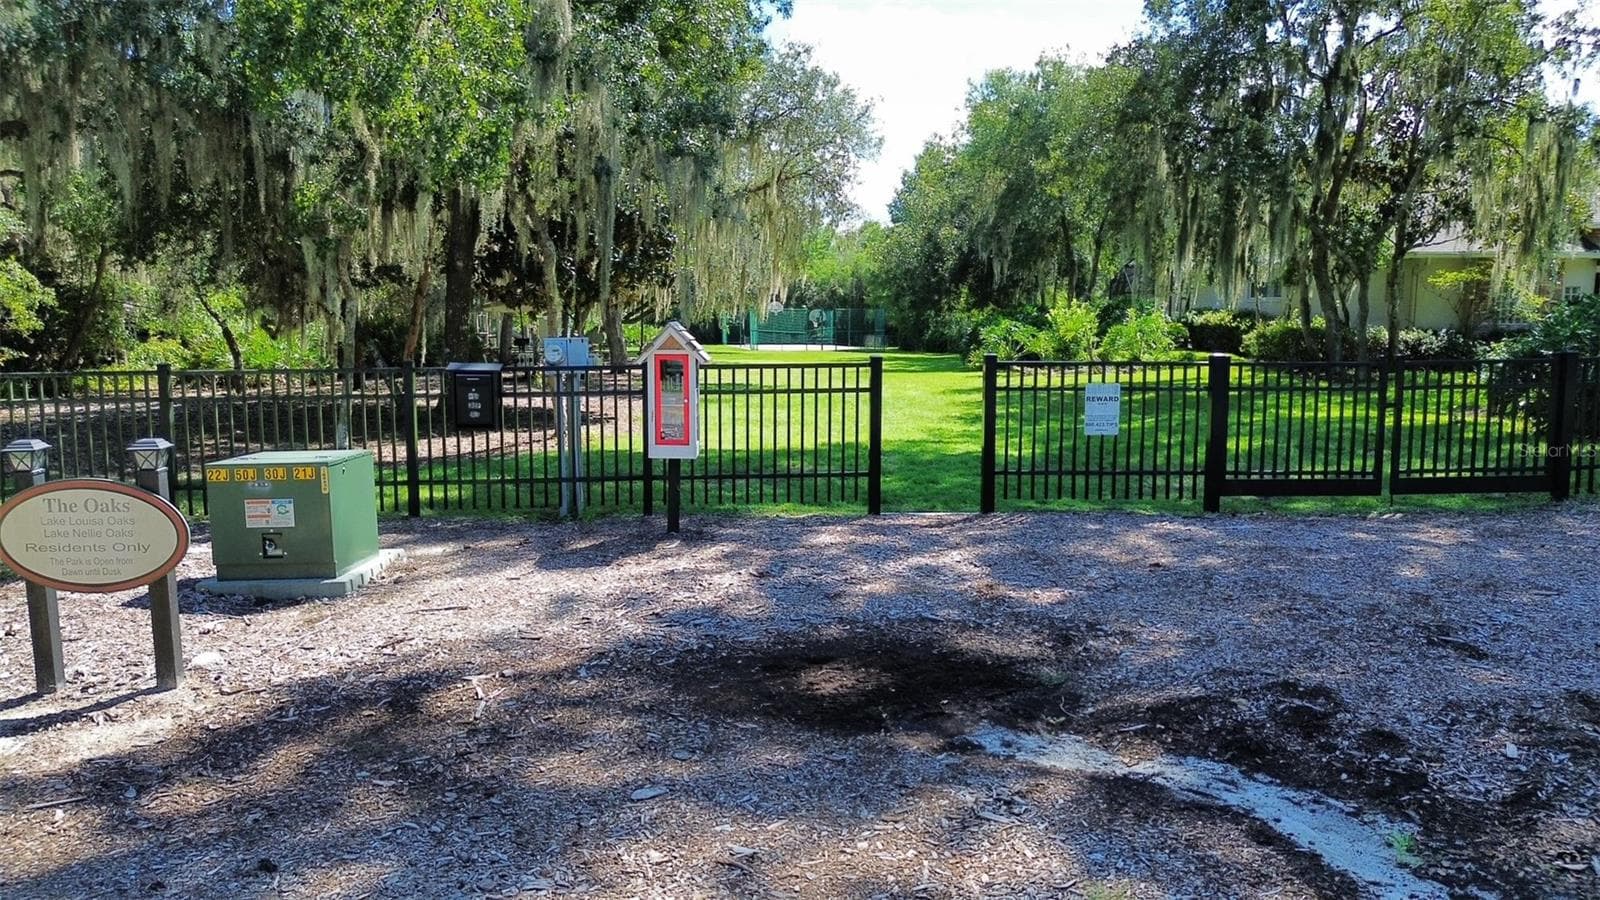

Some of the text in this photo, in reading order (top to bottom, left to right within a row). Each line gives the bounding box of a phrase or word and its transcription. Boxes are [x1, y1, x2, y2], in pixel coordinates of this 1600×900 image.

[208, 469, 229, 481] 22J
[236, 468, 256, 480] 50J
[264, 468, 286, 480] 30J
[294, 467, 315, 480] 21J
[43, 498, 130, 513] The Oaks
[41, 516, 136, 526] Lake Louisa Oaks
[43, 528, 134, 538] Lake Nellie Oaks
[25, 542, 151, 554] Residents Only
[50, 557, 134, 568] The Park is Open from
[61, 567, 122, 576] Dawn until Dusk
